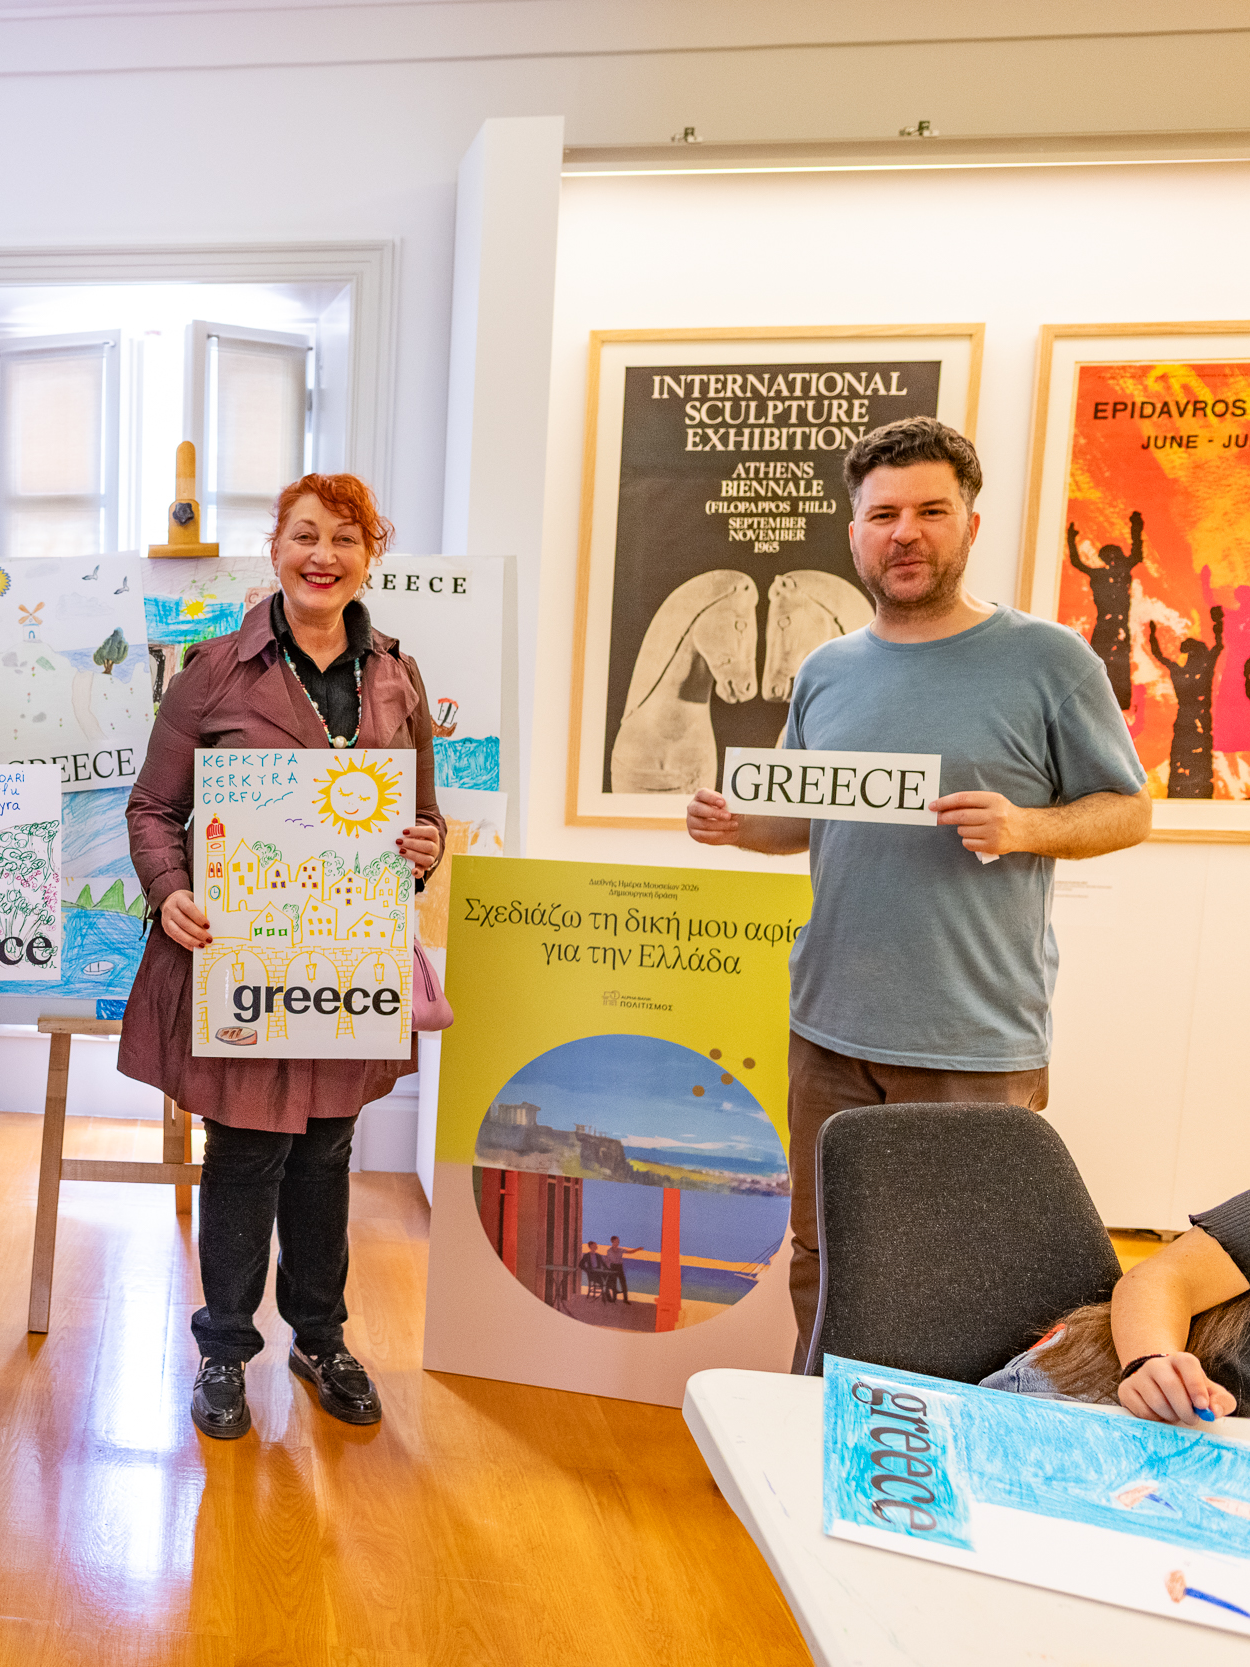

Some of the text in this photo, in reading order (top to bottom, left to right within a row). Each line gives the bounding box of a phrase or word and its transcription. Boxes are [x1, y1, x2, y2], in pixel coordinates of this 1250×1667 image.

[651, 371, 907, 399] INTERNATIONAL
[684, 399, 869, 425] SCULPTURE
[1093, 398, 1247, 420] EPIDAVROS
[685, 426, 866, 451] EXHIBITION
[1141, 434, 1199, 450] JUNE
[732, 461, 814, 479] ATHENS
[720, 479, 824, 497] BIENNALE
[705, 499, 837, 515] (FILOPAPPOS HILL)
[728, 516, 806, 529] SEPTEMBER
[729, 529, 806, 541] NOVEMBER
[754, 541, 780, 553] 1965
[8, 748, 136, 783] EECE
[202, 772, 298, 788] KERKYRA
[731, 762, 926, 810] GREECE
[202, 791, 262, 804] CORFU
[464, 898, 582, 932] Σχεδιάζω
[588, 911, 618, 937] τη
[625, 907, 680, 941] δική
[687, 918, 738, 942] μου
[541, 942, 742, 975] για την Ελλάδα
[233, 984, 401, 1023] greece
[620, 1000, 672, 1012] ΠΟΛΙΤΙΣΜΟΣ
[851, 1381, 937, 1531] greece
